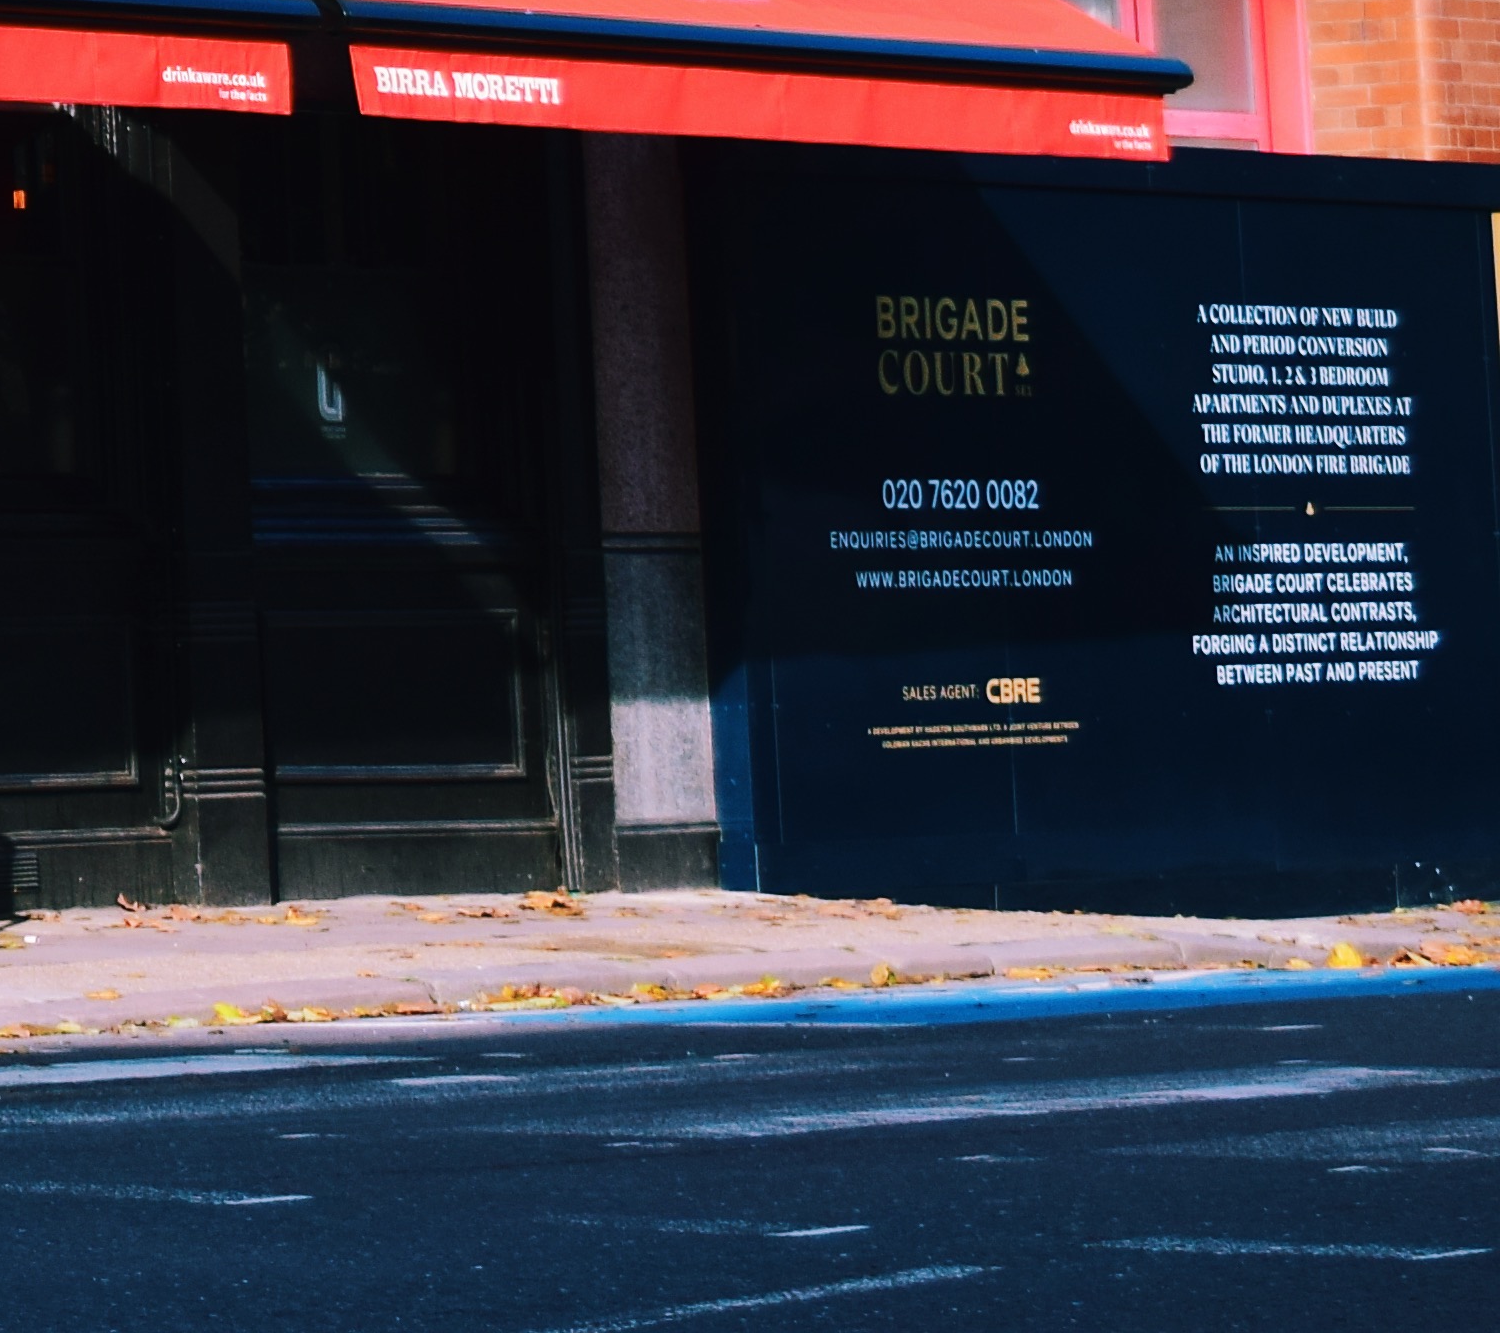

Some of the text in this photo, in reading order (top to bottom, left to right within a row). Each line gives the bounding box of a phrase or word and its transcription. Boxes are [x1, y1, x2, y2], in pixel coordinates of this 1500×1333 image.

[162, 65, 266, 88] drinkaware.co.uk
[375, 65, 560, 105] BIRRA MORETTI
[876, 296, 1029, 342] BRIGADE
[1197, 304, 1397, 329] A COLLECTION OF NEW BUILD
[1210, 334, 1388, 357] AND PERIOD CONVERSION
[878, 349, 1009, 396] COURT
[1212, 364, 1268, 385] STUDIO,
[1285, 366, 1293, 385] 2
[1295, 366, 1306, 385] &
[1310, 366, 1317, 385] 3
[1319, 366, 1389, 387] BEDROOM
[1192, 393, 1412, 416] APARTMENTS AND DUPLEXES AT
[1201, 423, 1406, 449] THE FORMER HEADQUARTERS
[1200, 453, 1411, 475] OF THE LONDON FIRE BRIGADE
[882, 479, 1039, 509] 020 7620 0082
[830, 530, 1093, 550] ENQUIRIES@BRIGADECOURT.LONDON
[1214, 542, 1408, 564] AN INSPIRED DEVELOPMENT,
[855, 569, 1072, 588] WWW.BRIGADECOURT.LONDON
[1213, 572, 1413, 594] BRIGADE COURT CELEBRATES
[1213, 601, 1417, 623] ARCHITECTURAL CONTRASTS,
[1192, 630, 1439, 655] FORGING A DISTINCT RELATIONSHIP
[1216, 660, 1419, 685] BETWEEN PAST AND PRESENT
[902, 677, 1041, 704] SALES AGENT: CBRE
